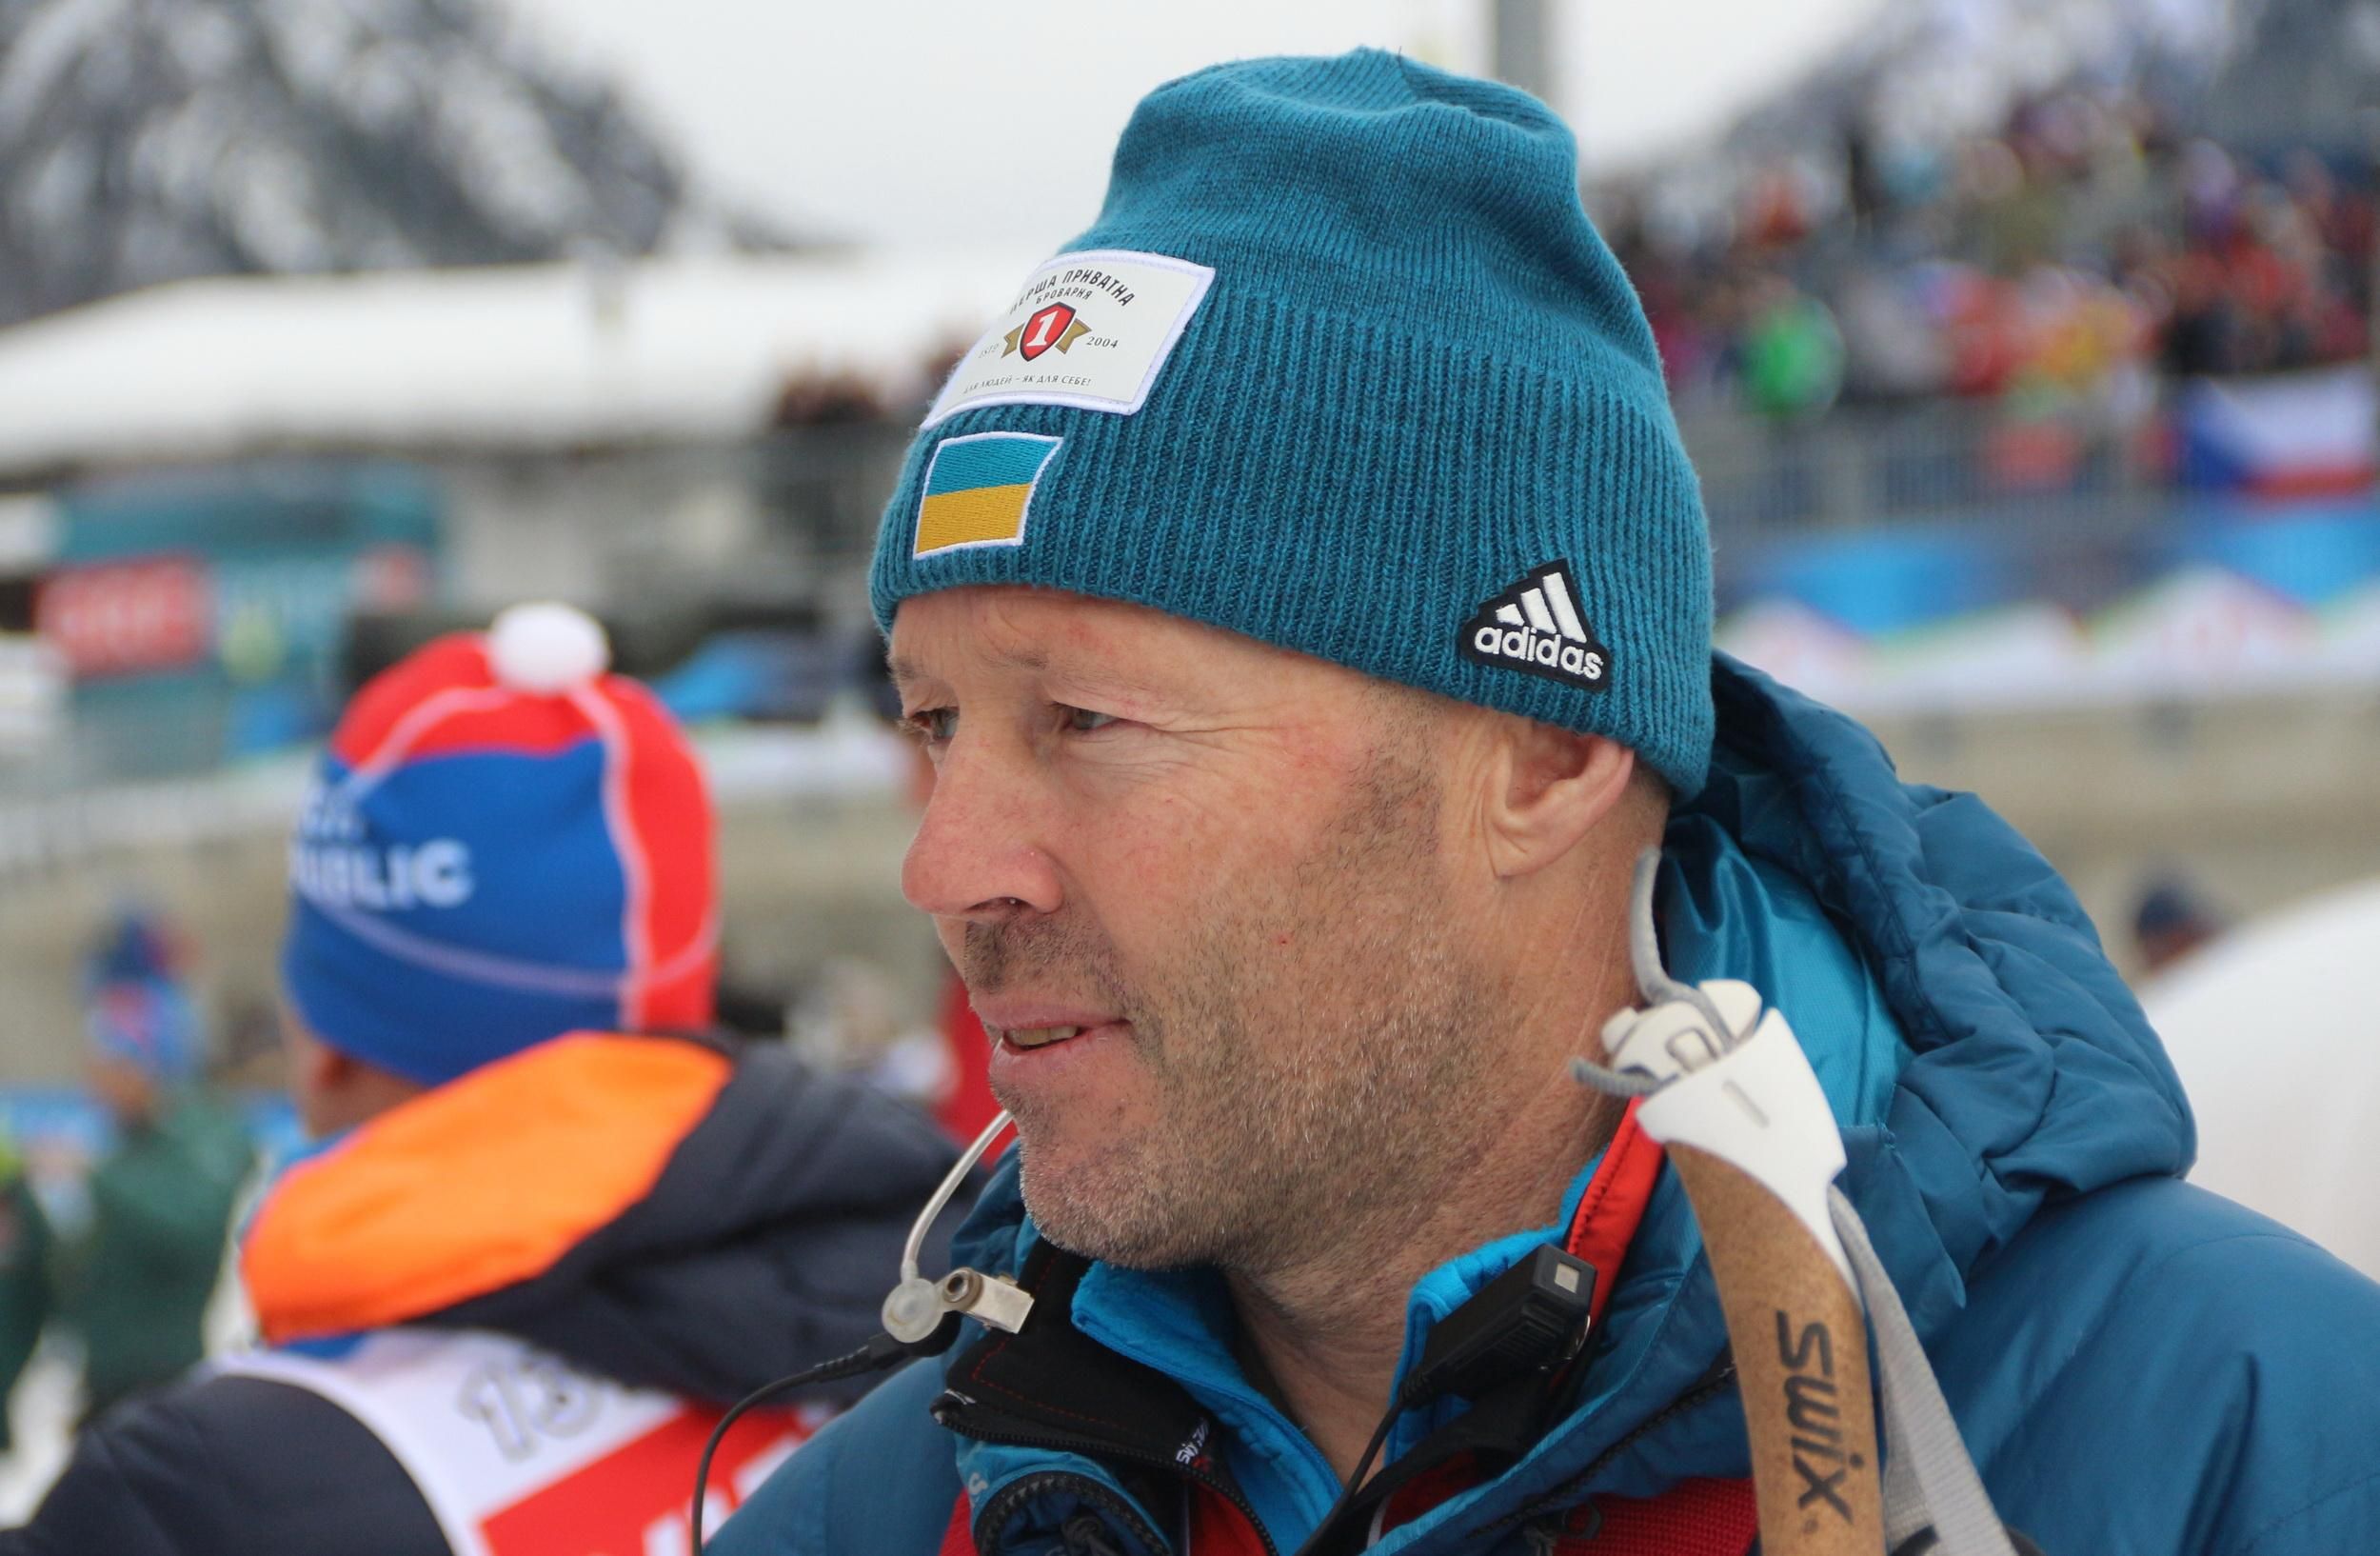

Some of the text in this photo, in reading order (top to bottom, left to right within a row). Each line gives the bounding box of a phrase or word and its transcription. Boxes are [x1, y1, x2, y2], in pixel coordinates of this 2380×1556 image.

[1036, 287, 1093, 305] БРОВАРНЯ
[1061, 269, 1136, 307] ПРИВАТНА
[1086, 335, 1120, 349] 2004
[1037, 375, 1059, 384] ДЛЯ
[1061, 375, 1092, 387] СЕБЕ!
[1474, 626, 1604, 680] adidas
